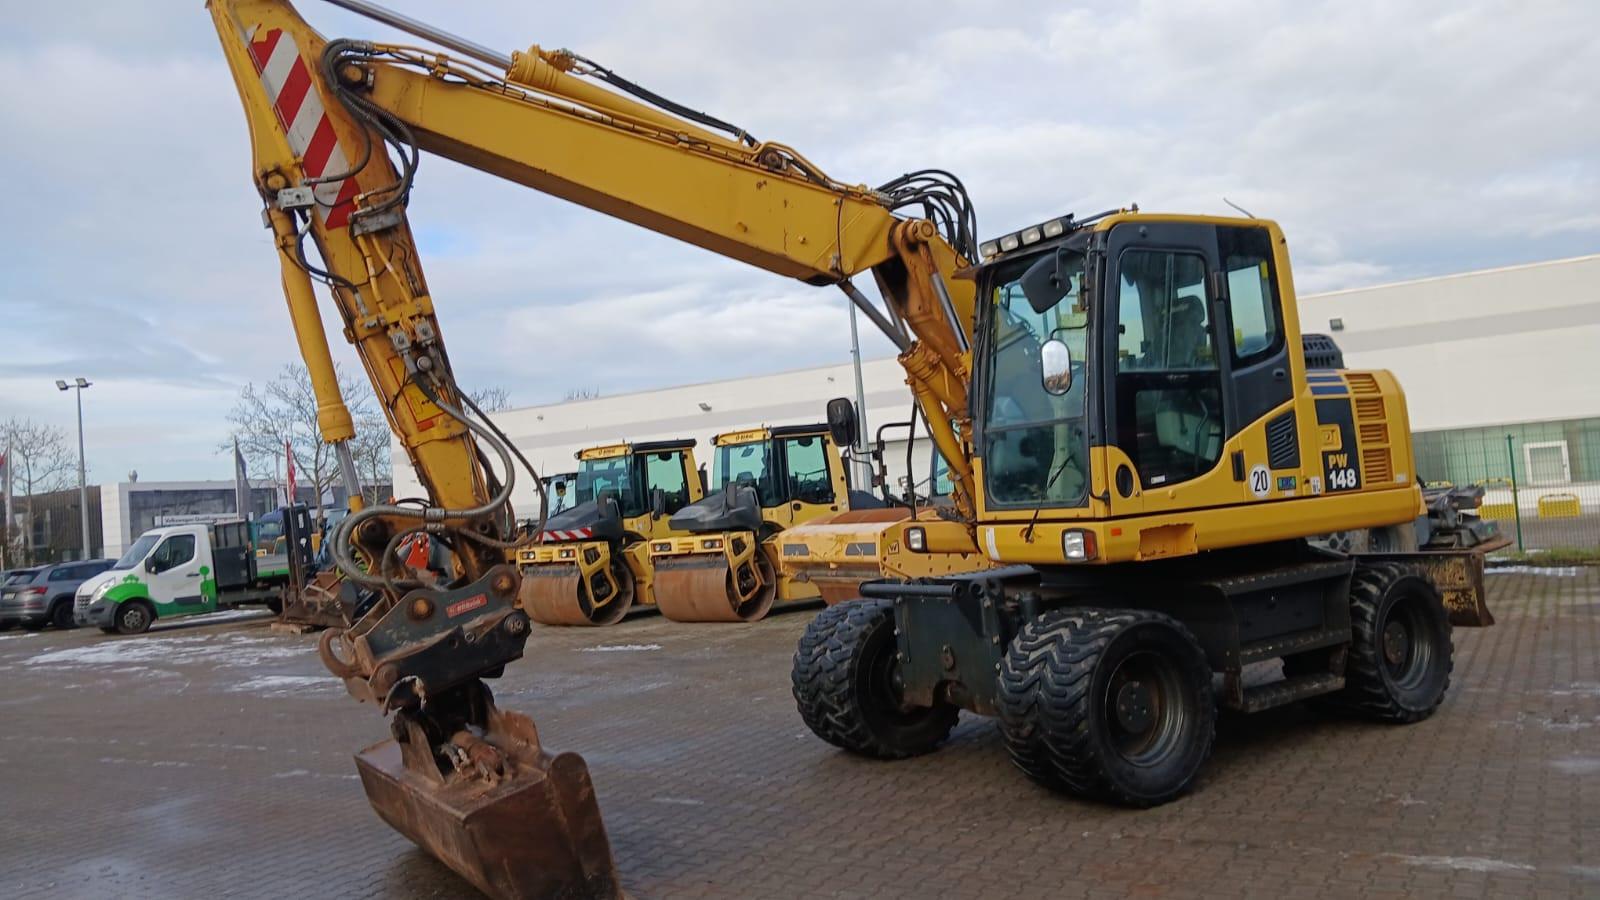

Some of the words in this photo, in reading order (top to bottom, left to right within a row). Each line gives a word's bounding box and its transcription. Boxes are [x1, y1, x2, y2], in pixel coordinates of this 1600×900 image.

[1328, 453, 1348, 469] PW
[1253, 470, 1268, 492] 20
[1329, 468, 1357, 489] 148
